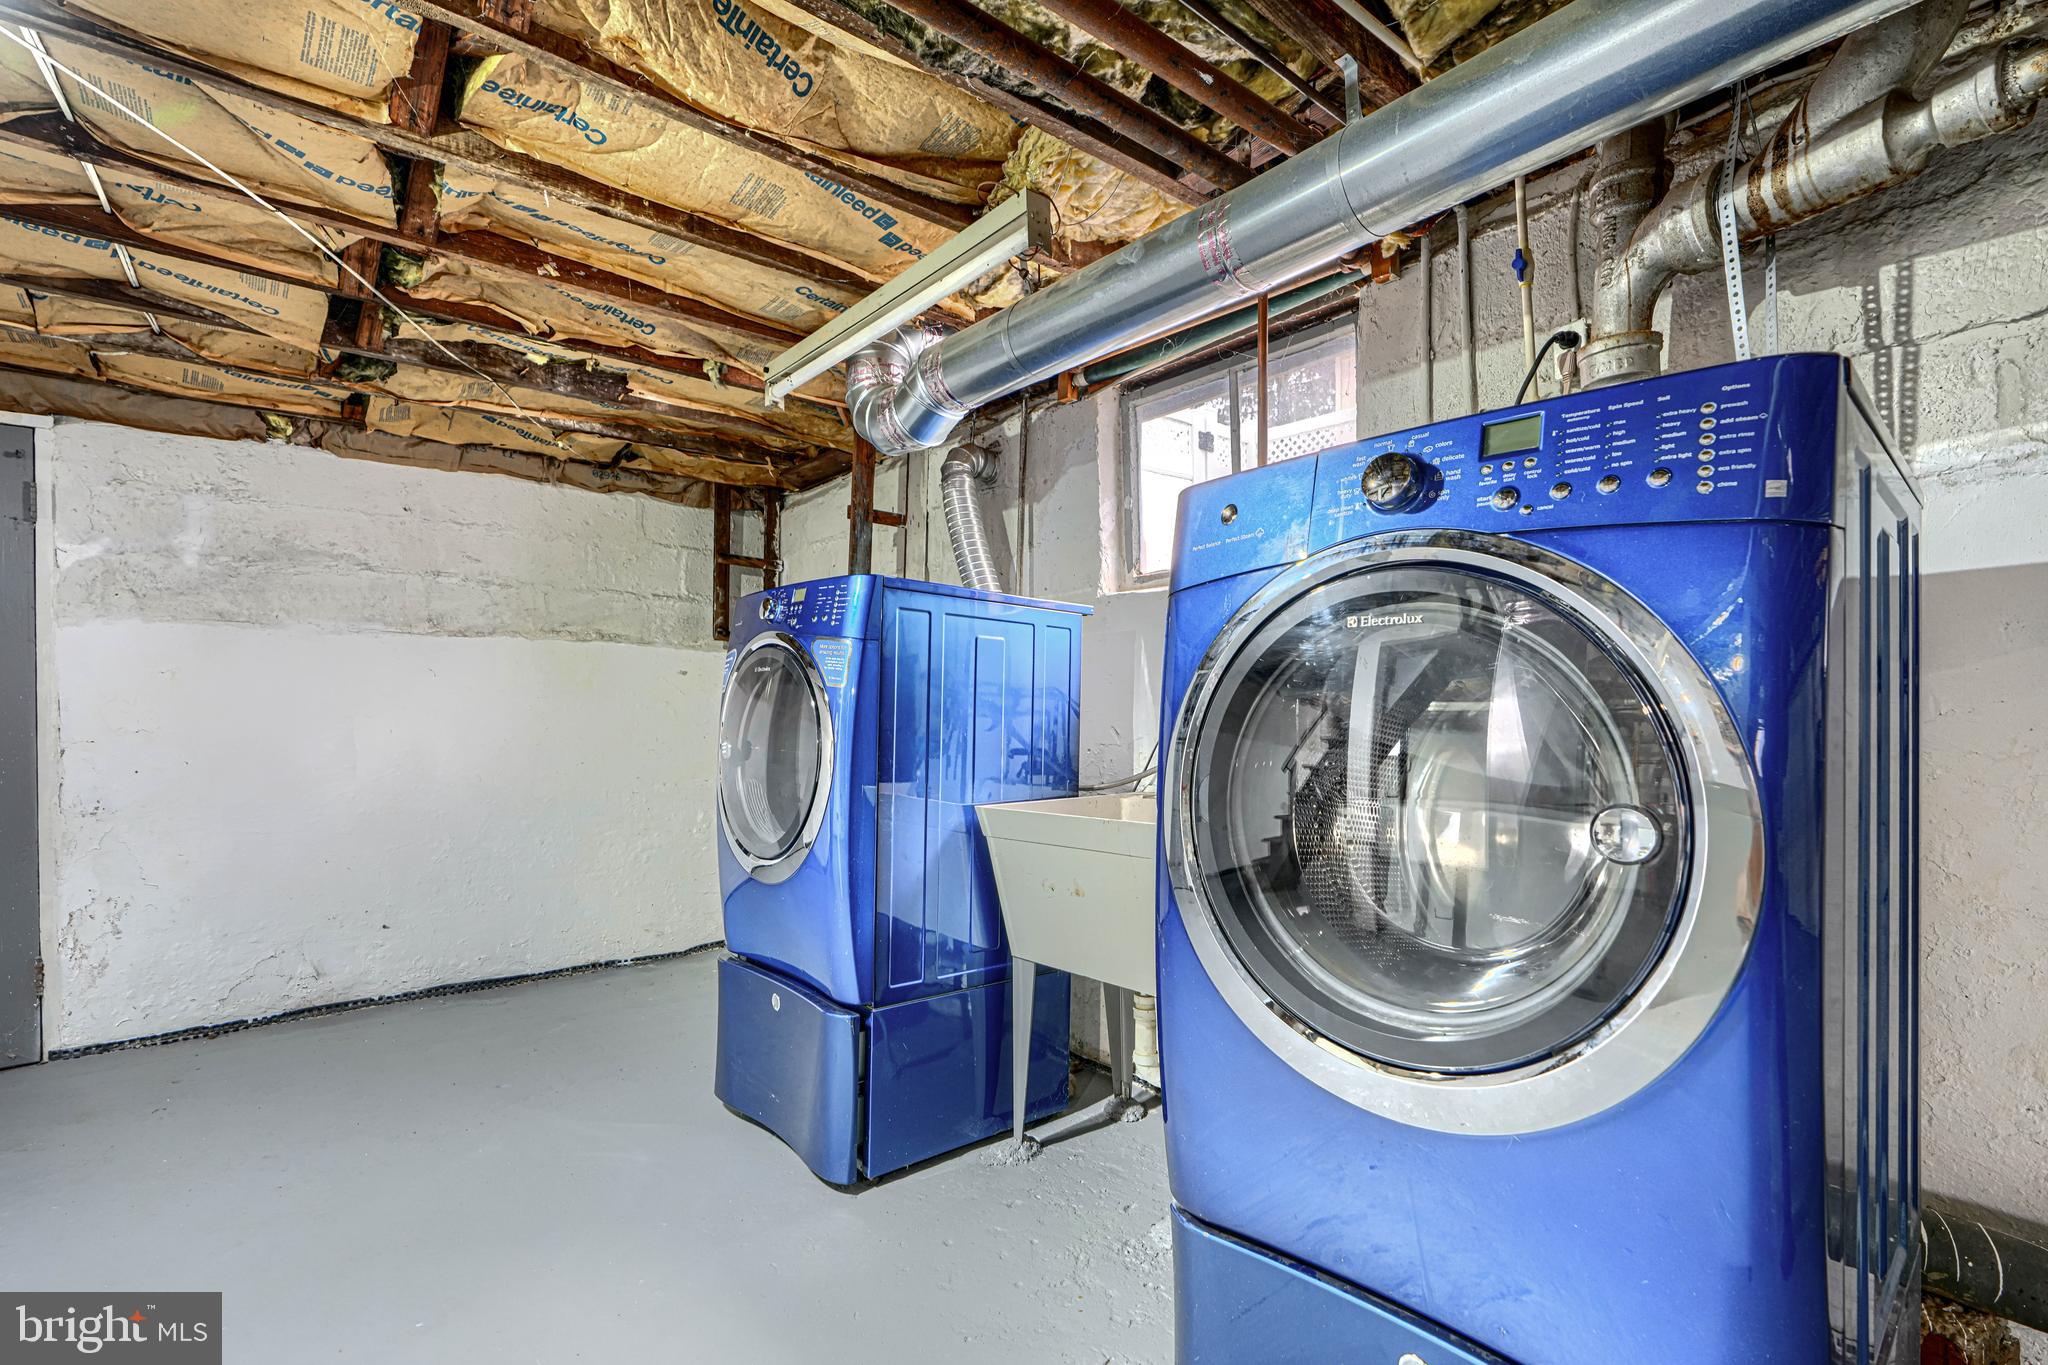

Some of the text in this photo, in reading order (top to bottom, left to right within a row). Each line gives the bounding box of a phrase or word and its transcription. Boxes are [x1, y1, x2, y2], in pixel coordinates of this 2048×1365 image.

[712, 0, 814, 98] CertainTe
[480, 79, 608, 146] CertainTee
[138, 260, 281, 317] CertainTeed
[795, 285, 851, 312] Certain
[1721, 383, 1751, 392] Options
[1608, 399, 1644, 411] Spin Speed
[1720, 400, 1749, 410] prewash
[1561, 408, 1601, 419] Temperature
[1678, 407, 1697, 415] heavy
[1411, 432, 1430, 440] casual
[1373, 440, 1393, 448] normal
[1434, 440, 1453, 448] colors
[1441, 453, 1465, 462] delicate
[1730, 462, 1757, 470] friendly
[1360, 612, 1424, 627] Electrolux
